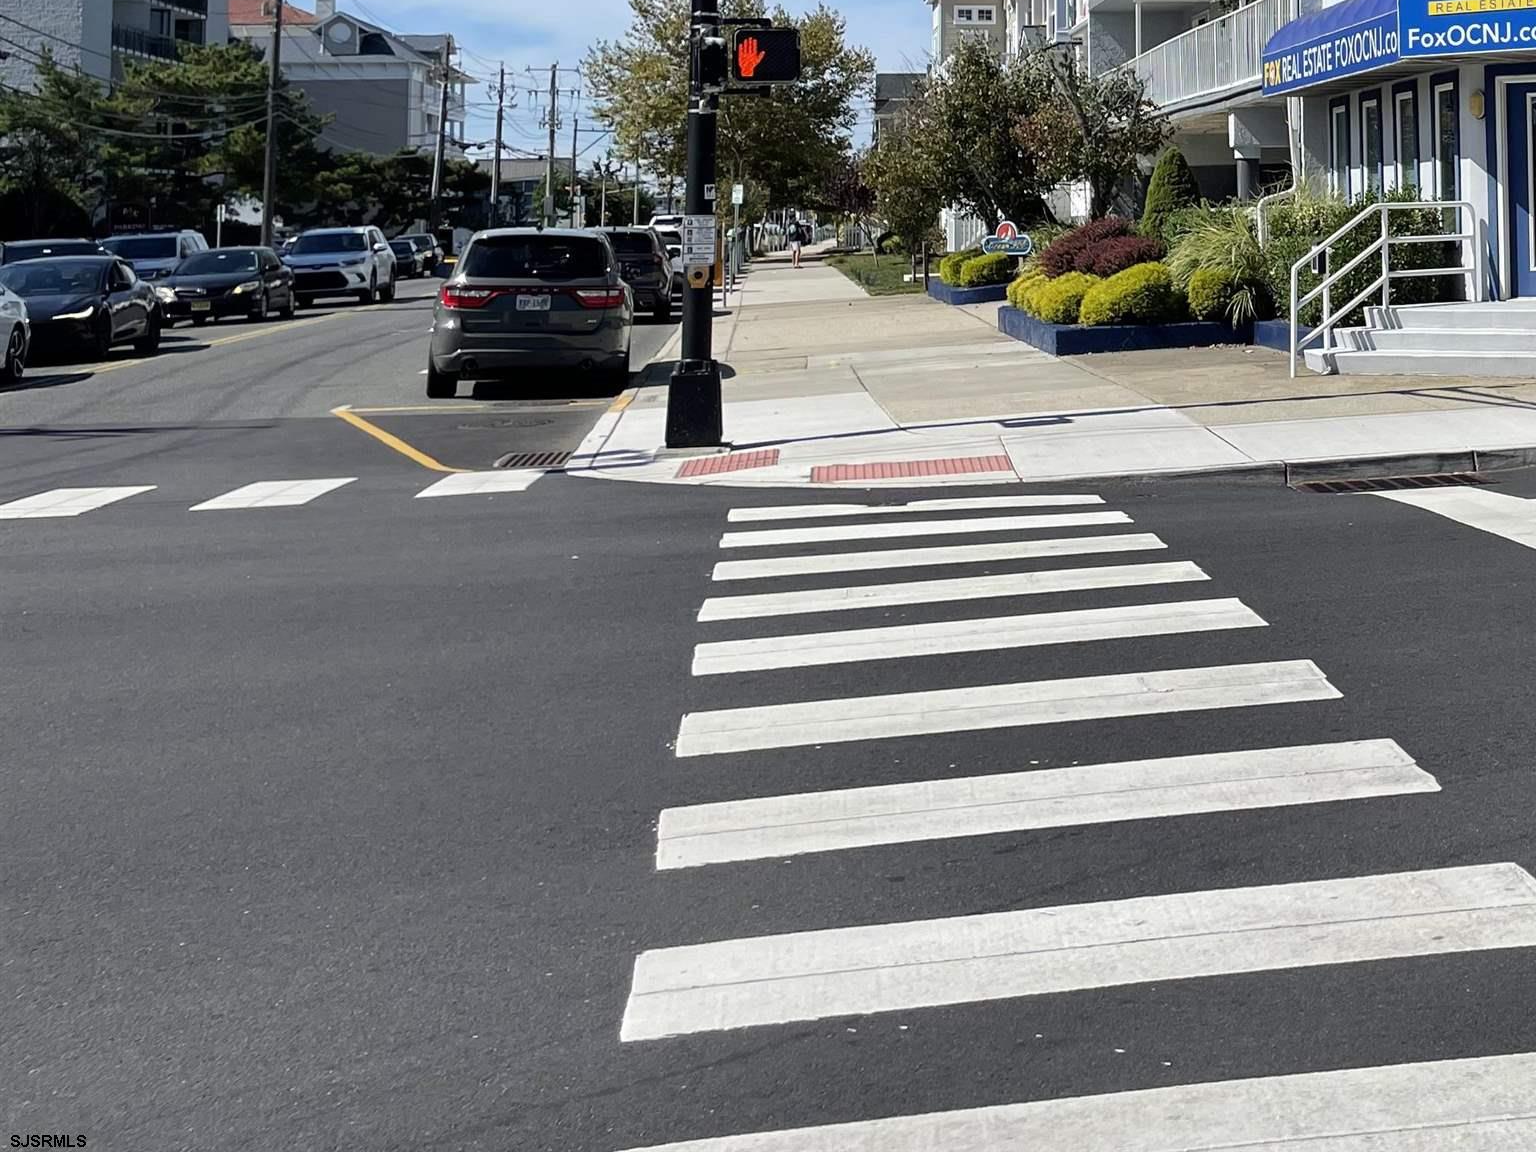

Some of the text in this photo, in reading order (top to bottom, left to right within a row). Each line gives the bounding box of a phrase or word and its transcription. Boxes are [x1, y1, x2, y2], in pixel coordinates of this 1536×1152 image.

[1435, 1, 1473, 14] REAL
[1264, 59, 1281, 88] FOX
[1281, 52, 1302, 83] REAL
[1302, 42, 1333, 78] ESTATE
